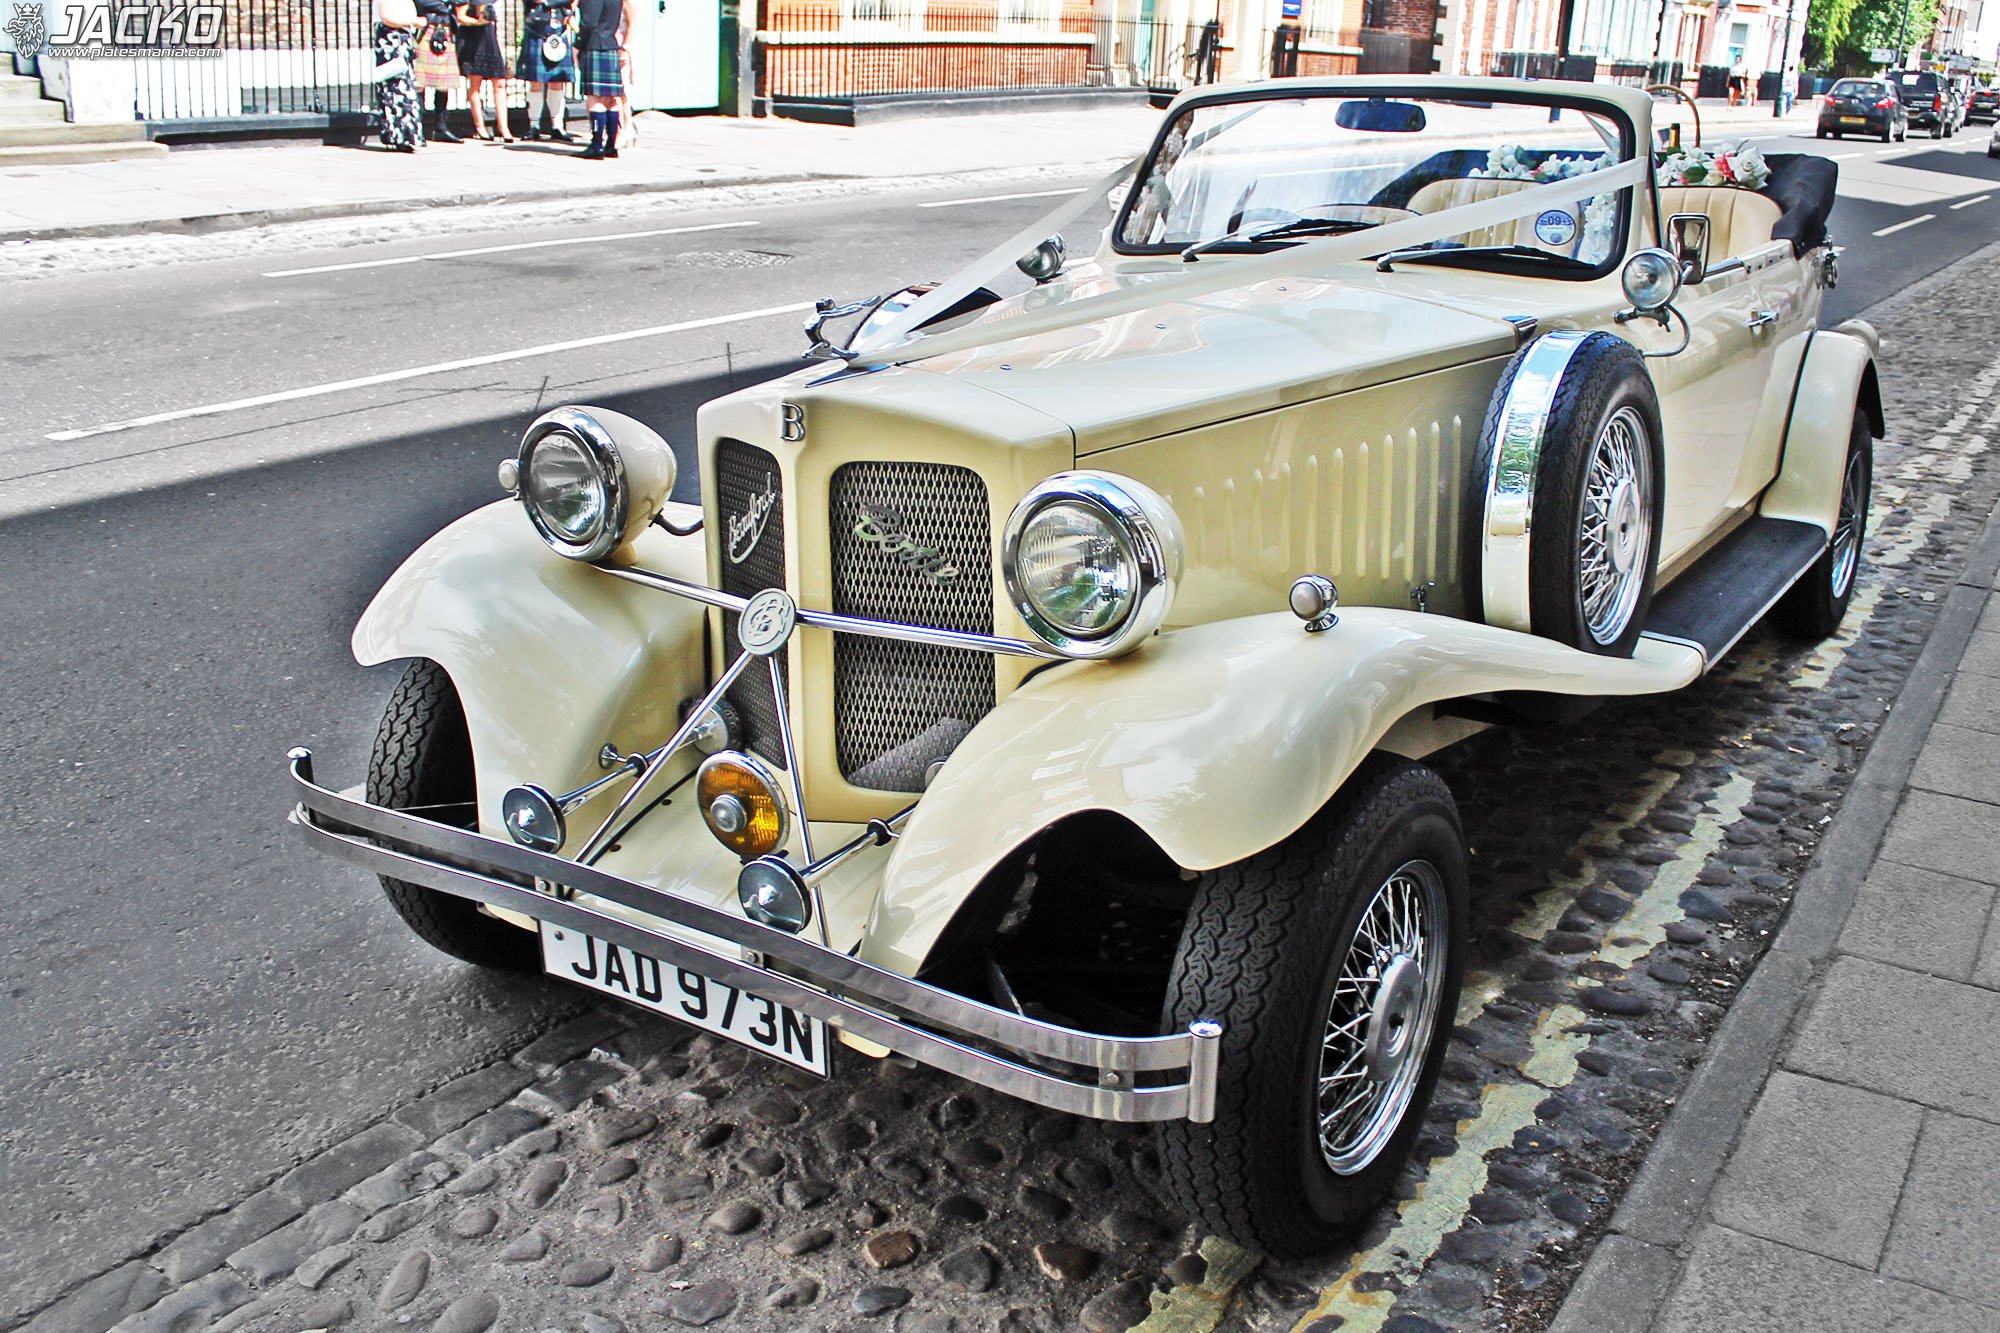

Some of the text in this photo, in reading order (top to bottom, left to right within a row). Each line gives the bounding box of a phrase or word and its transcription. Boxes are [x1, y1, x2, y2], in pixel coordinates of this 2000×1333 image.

[781, 402, 805, 442] B
[571, 934, 814, 1064] JAD 973N
